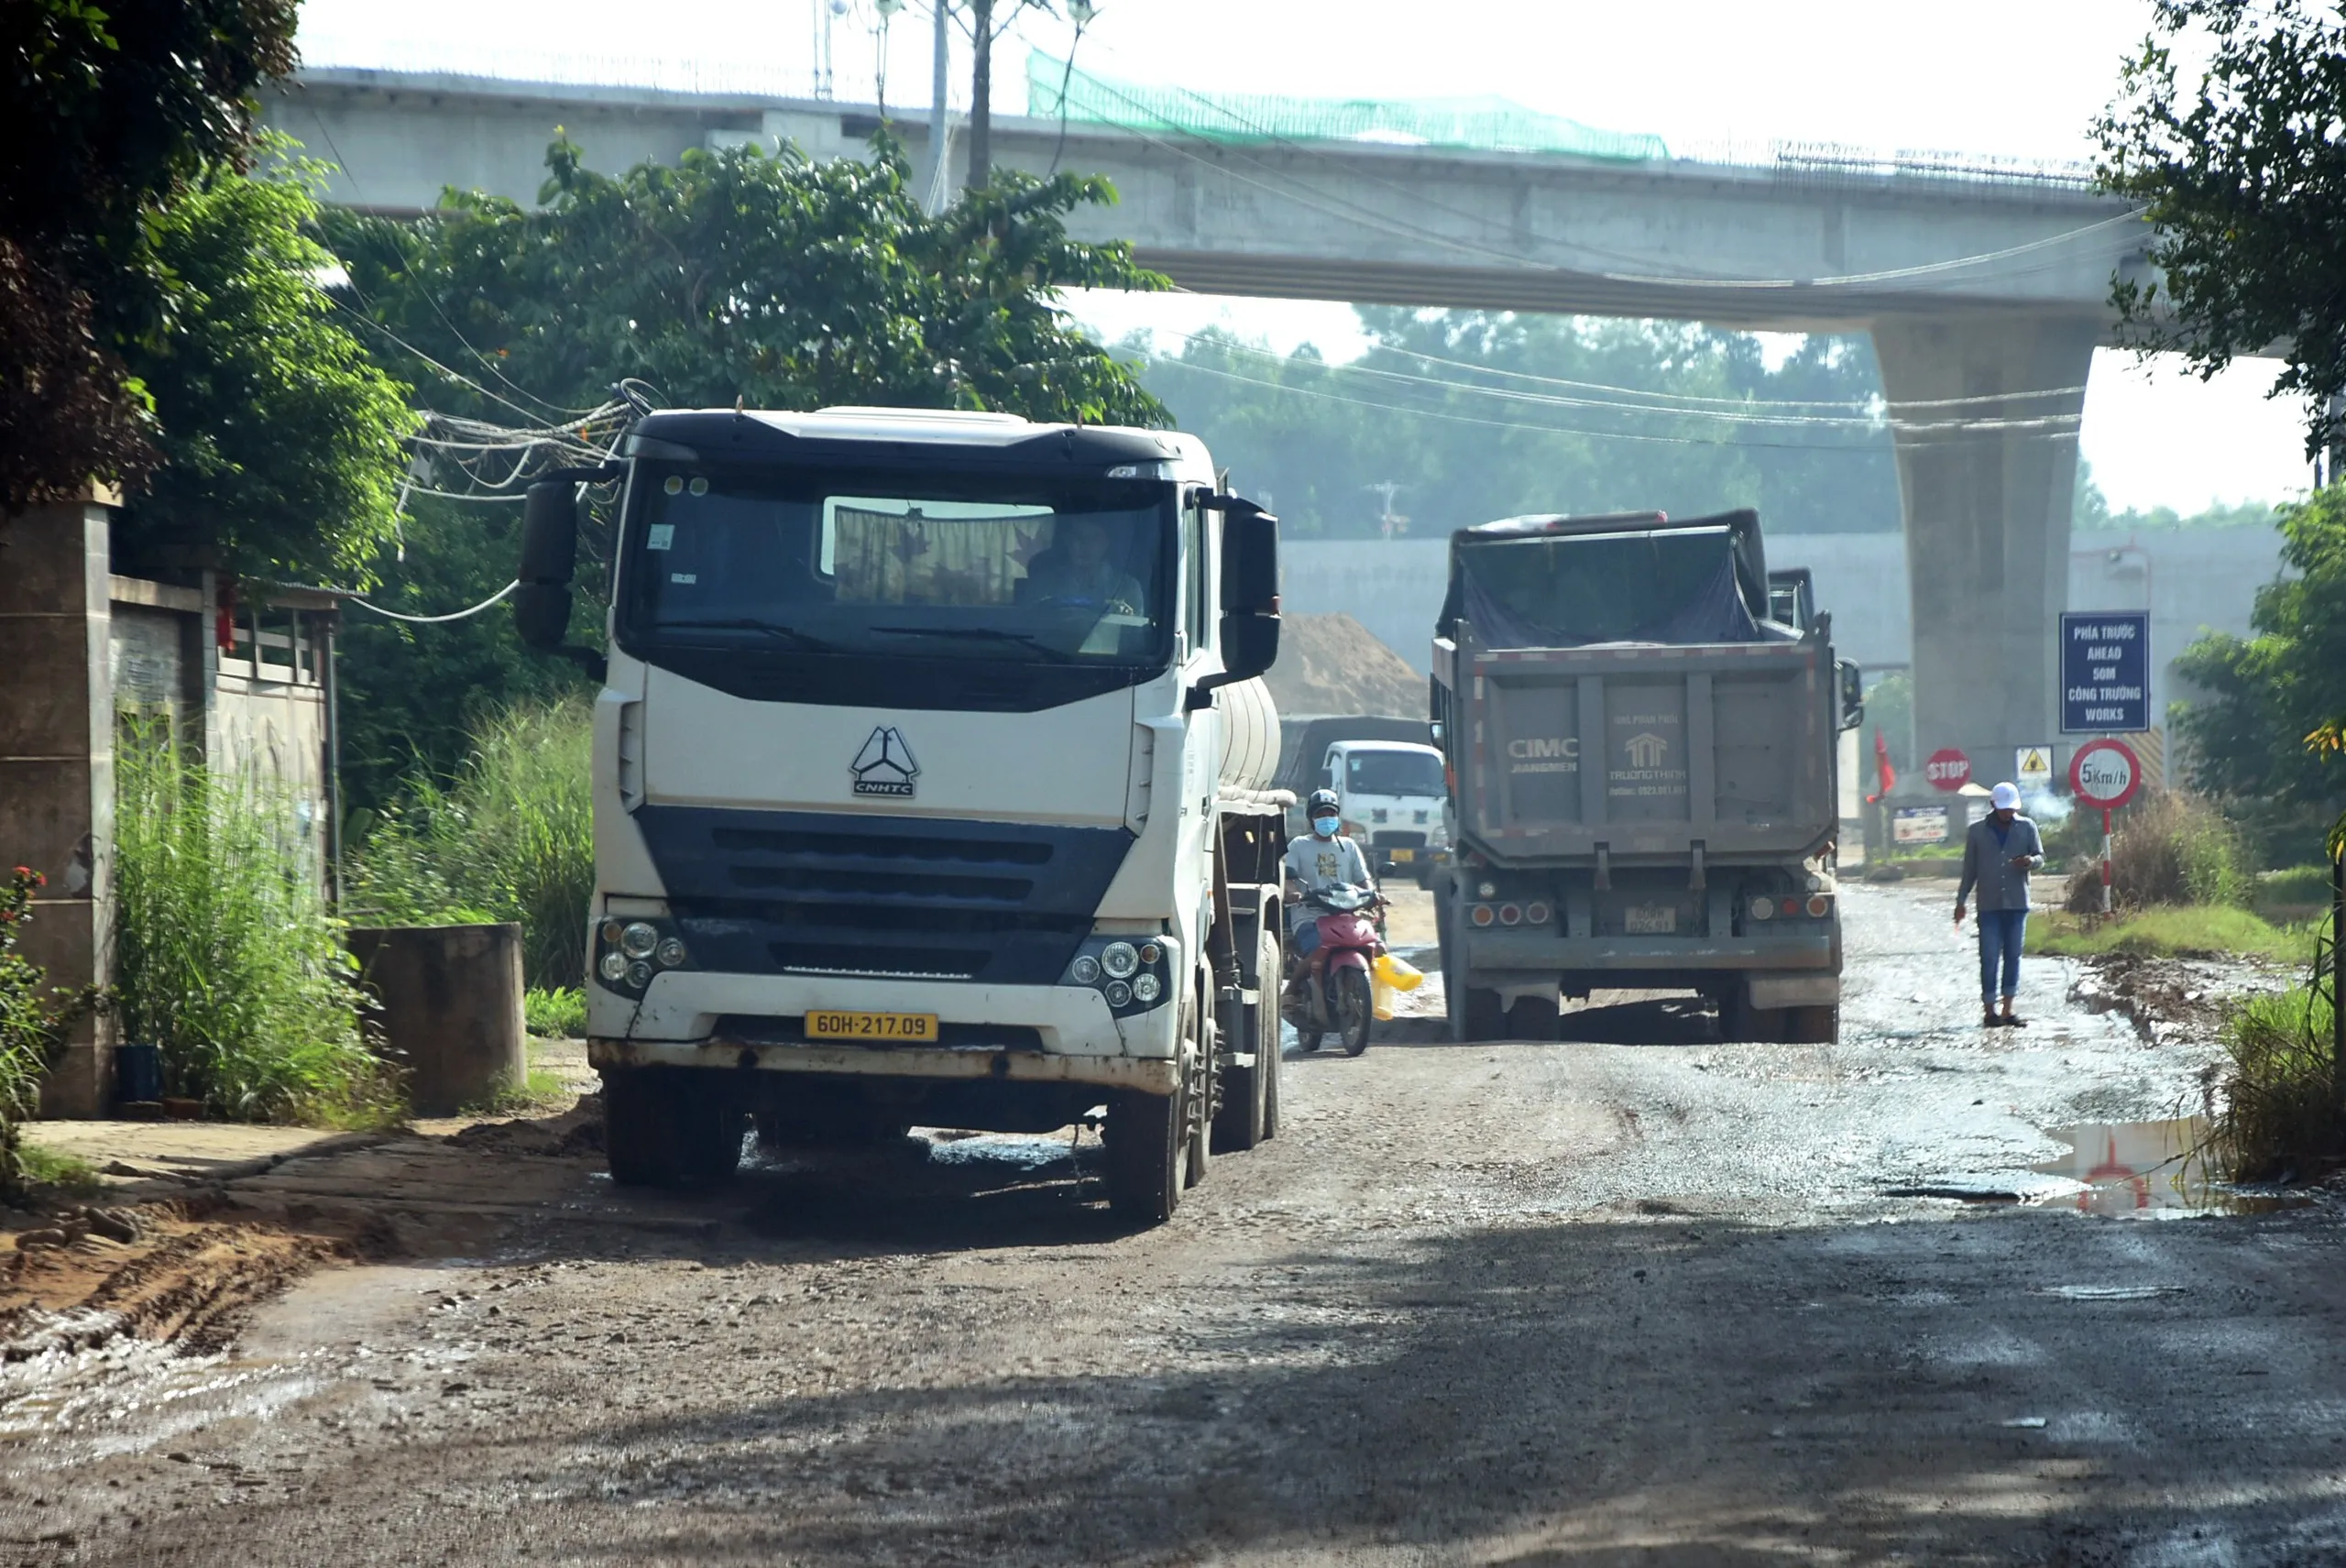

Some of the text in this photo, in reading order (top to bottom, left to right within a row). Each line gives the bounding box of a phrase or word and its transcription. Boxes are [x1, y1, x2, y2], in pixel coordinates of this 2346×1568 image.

[2074, 623, 2136, 640] PHÍA TRƯỚC
[2088, 646, 2121, 660] AHEAD
[2093, 667, 2116, 681] 50M
[2068, 685, 2097, 701] CÔNG
[2086, 707, 2124, 721] WORKS
[1507, 738, 1578, 758] CIMC
[1927, 761, 1968, 780] STOP
[856, 784, 911, 794] CNHTC
